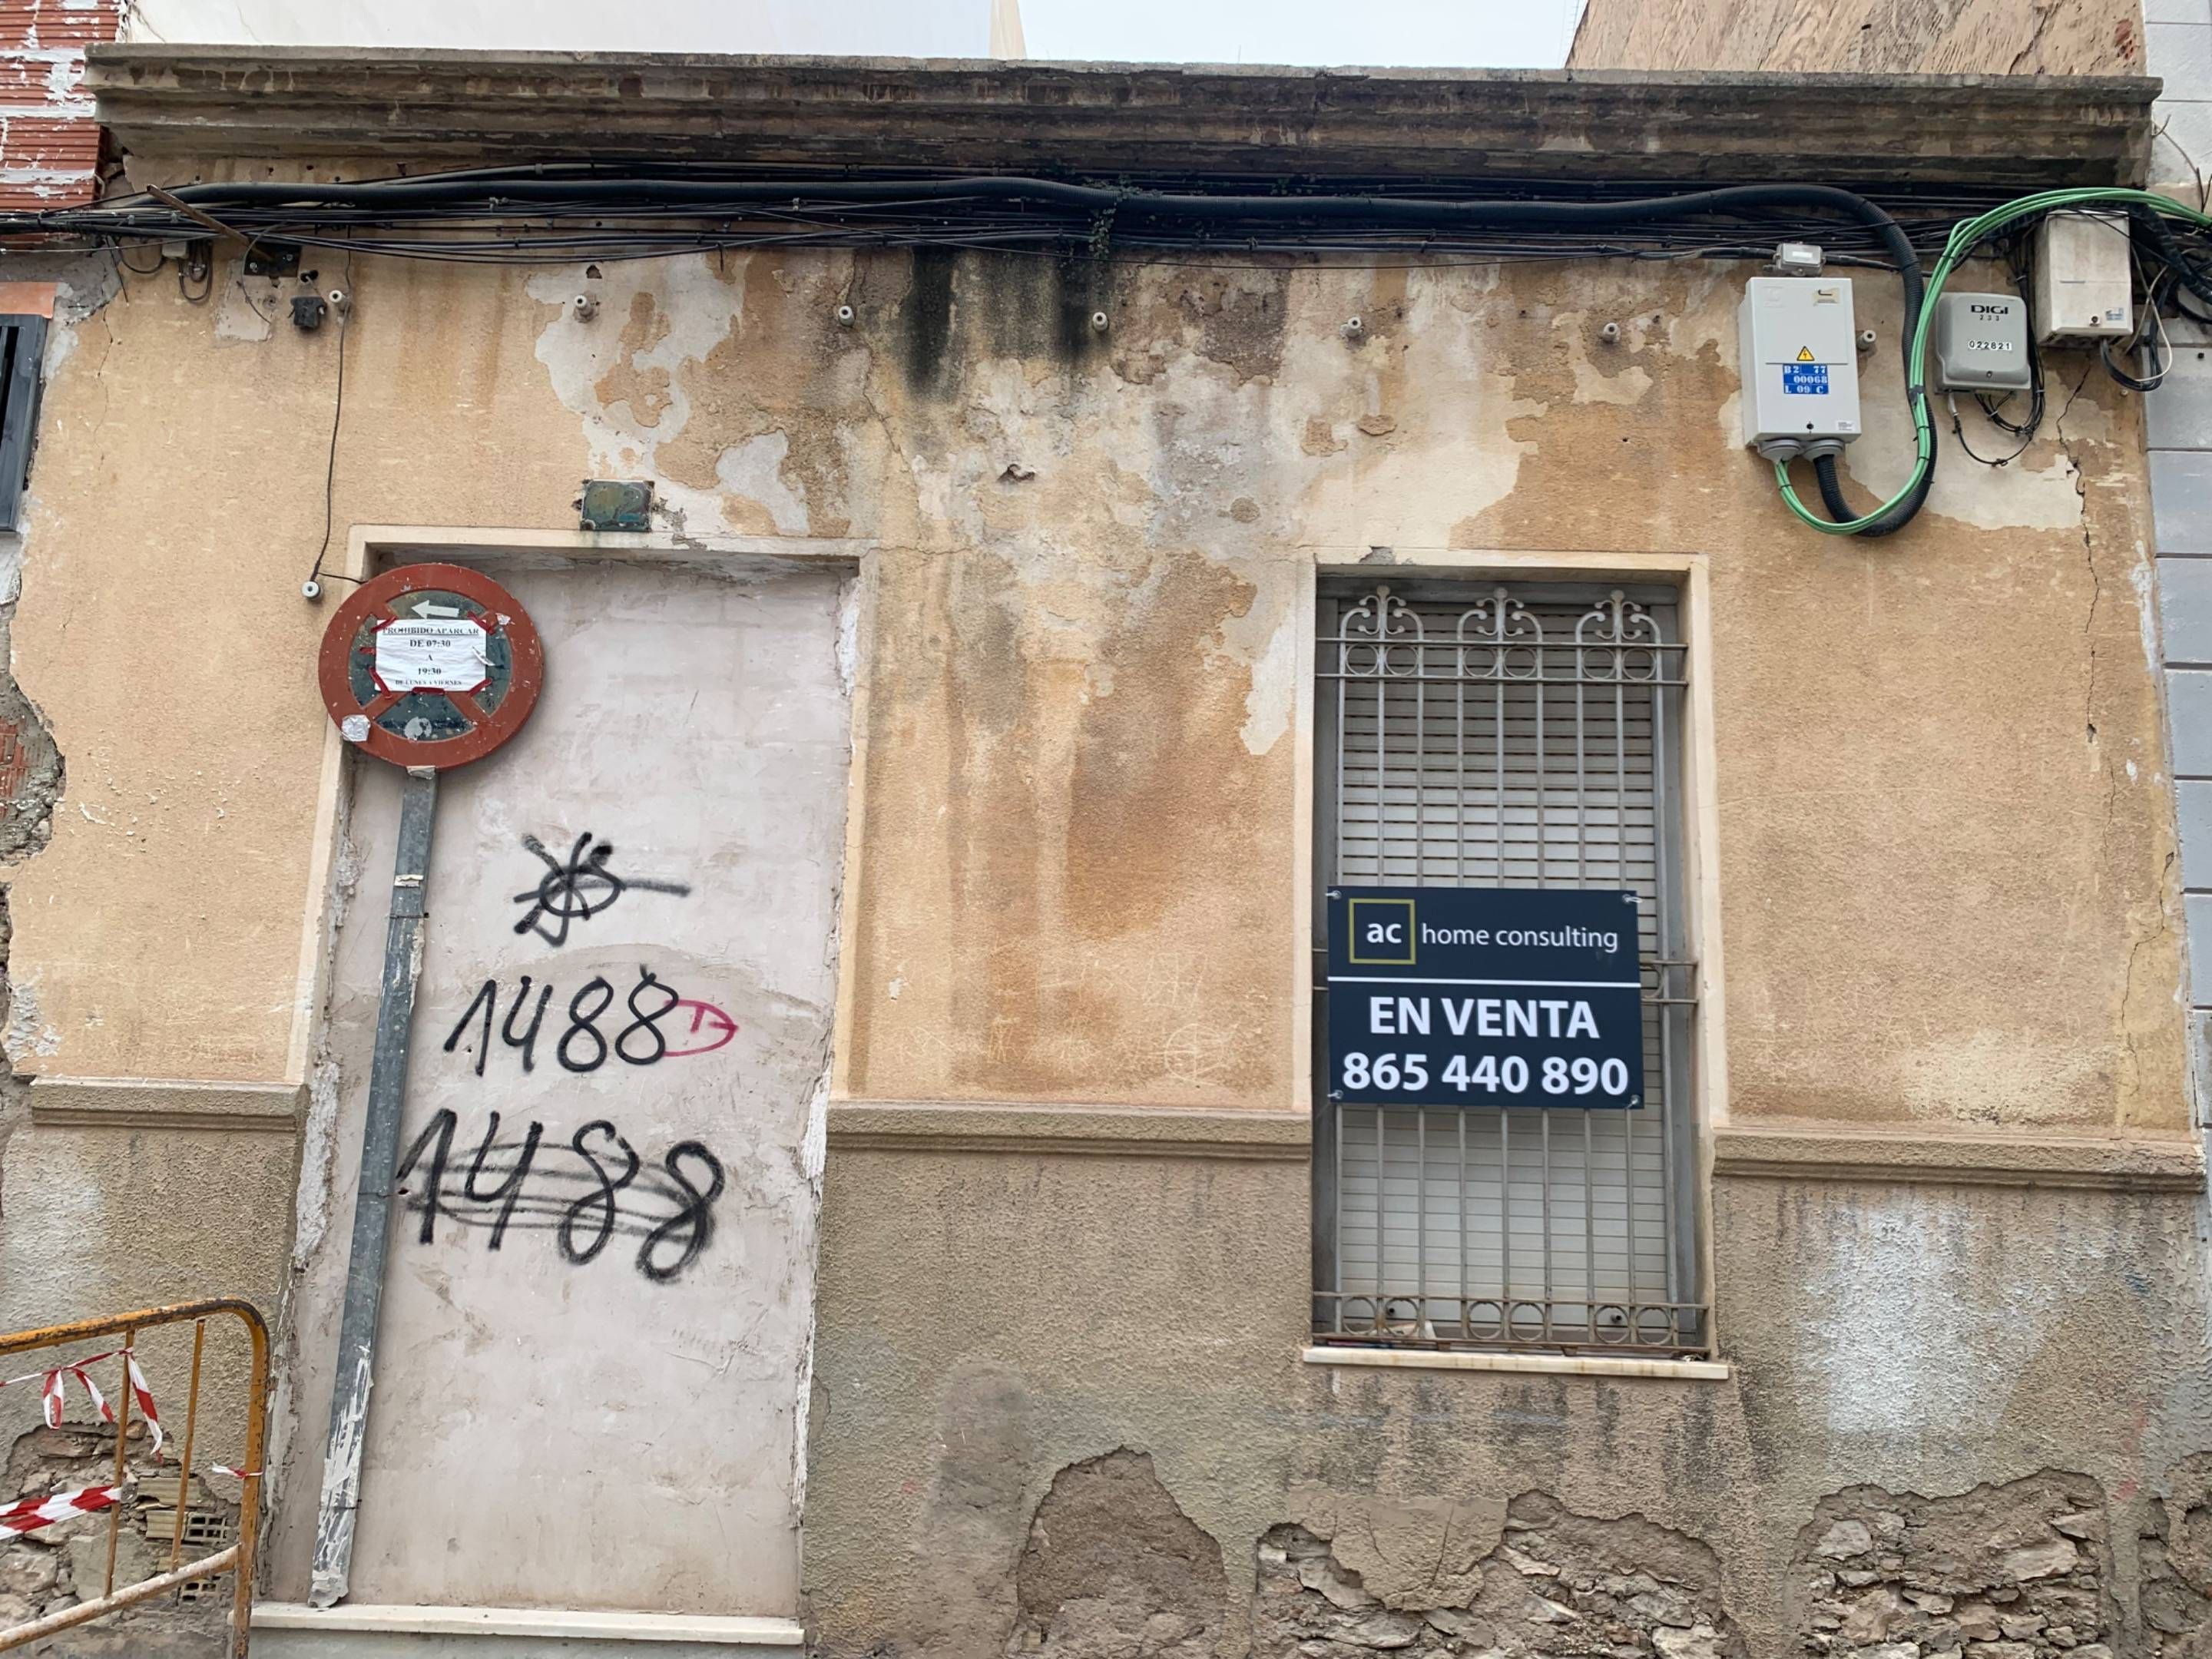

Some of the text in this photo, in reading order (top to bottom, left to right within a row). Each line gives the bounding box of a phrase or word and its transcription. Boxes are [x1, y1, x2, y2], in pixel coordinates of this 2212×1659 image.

[1971, 304, 2008, 314] DIGI
[1969, 340, 2011, 350] 022821
[1813, 365, 1826, 374] 77
[1816, 386, 1824, 394] C
[409, 639, 451, 647] DE 07:30
[418, 667, 442, 676] 19:30
[1366, 922, 1618, 953] ac home consulting
[1369, 996, 1601, 1039] EN VENTA
[443, 970, 680, 1076] 1488
[1343, 1052, 1628, 1096] 865 440 890
[396, 1108, 725, 1284] 1488
